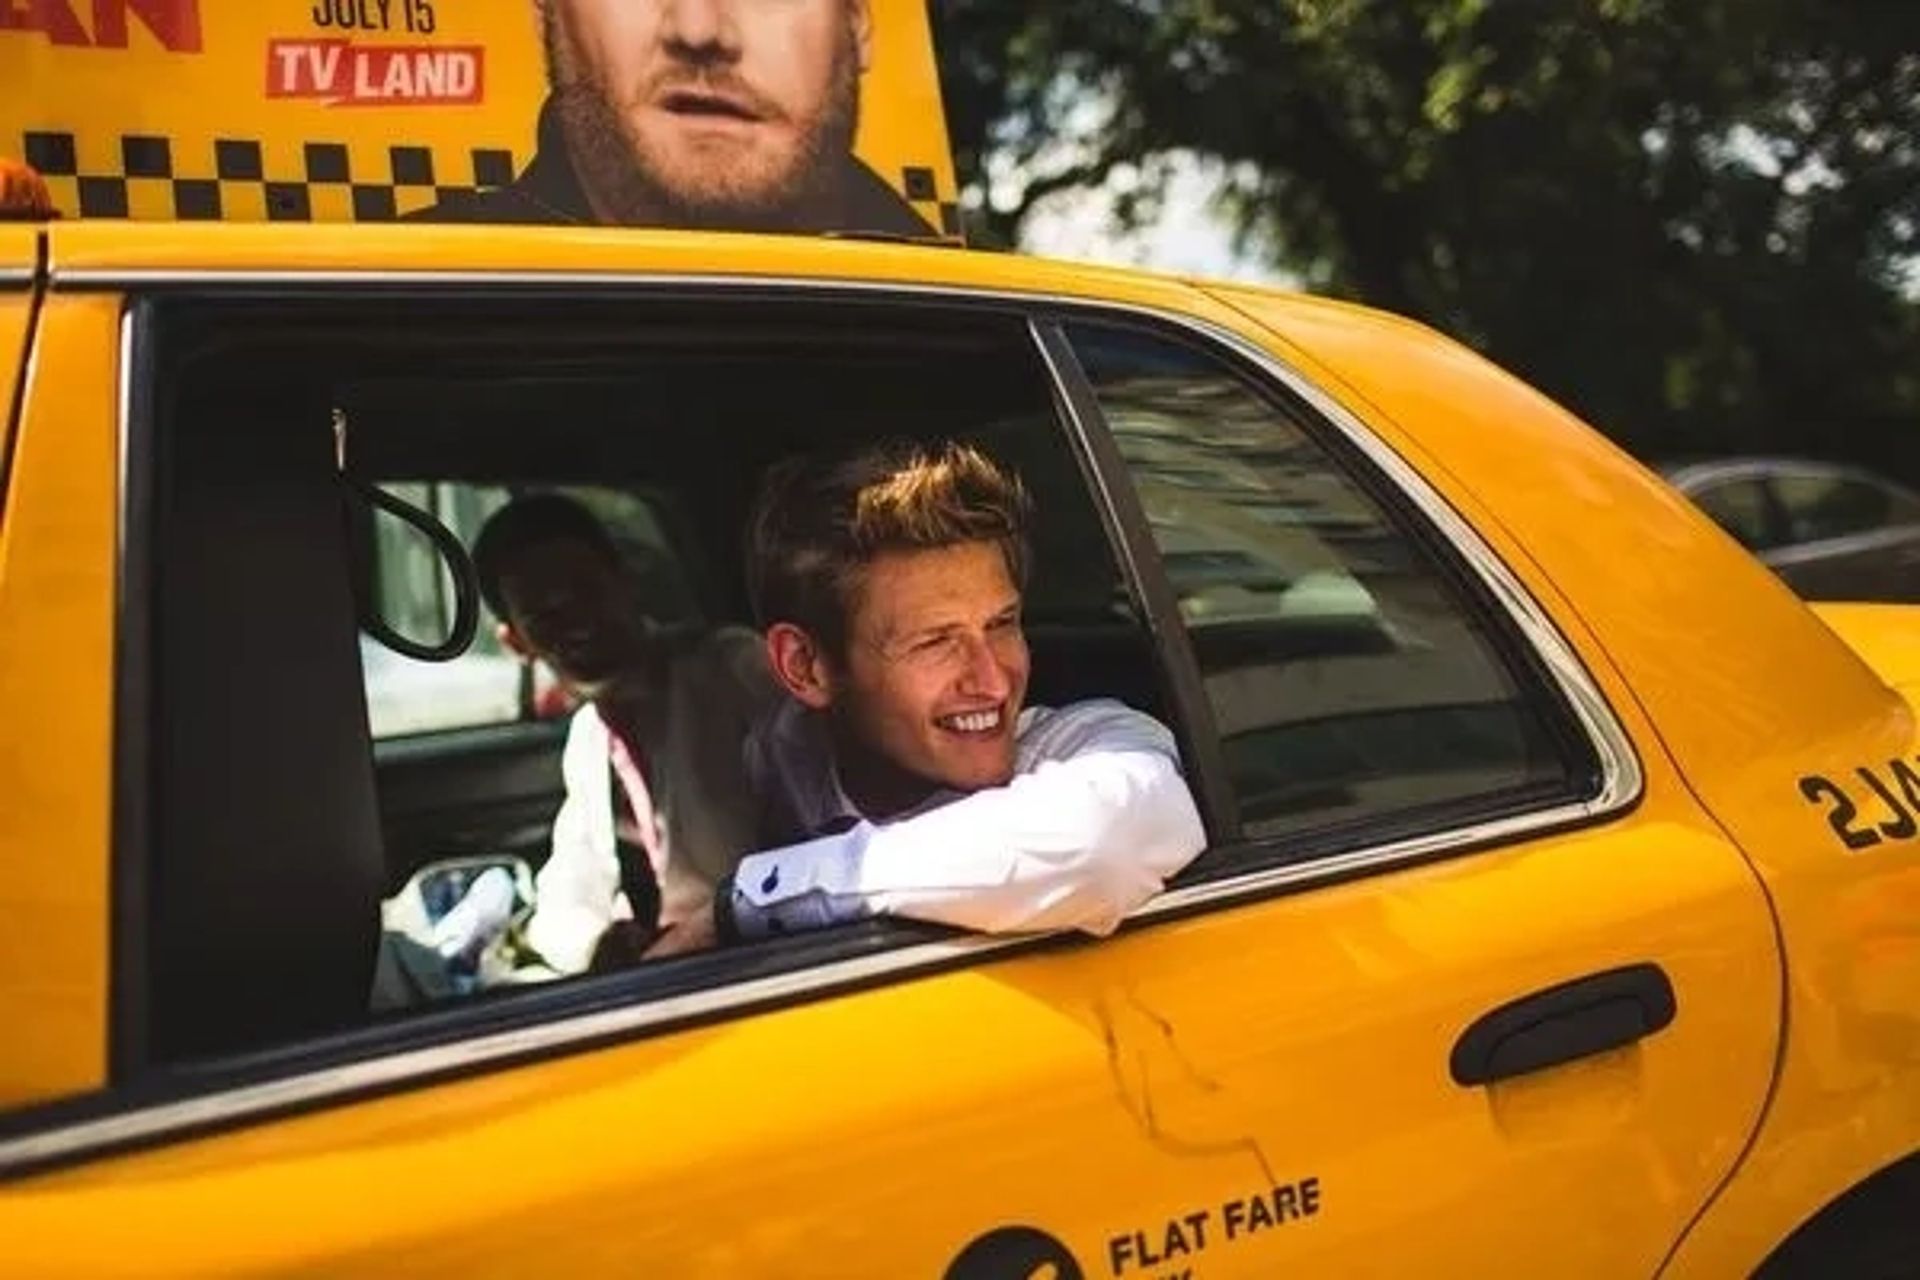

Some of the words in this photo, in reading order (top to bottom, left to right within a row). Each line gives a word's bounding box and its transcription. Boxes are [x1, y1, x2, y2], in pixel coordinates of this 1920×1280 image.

[312, 0, 391, 31] JULY
[404, 0, 435, 33] 15
[275, 44, 343, 92] TV
[354, 52, 476, 97] LAND
[1109, 1211, 1209, 1277] FLAT
[1223, 1178, 1321, 1240] FARE
